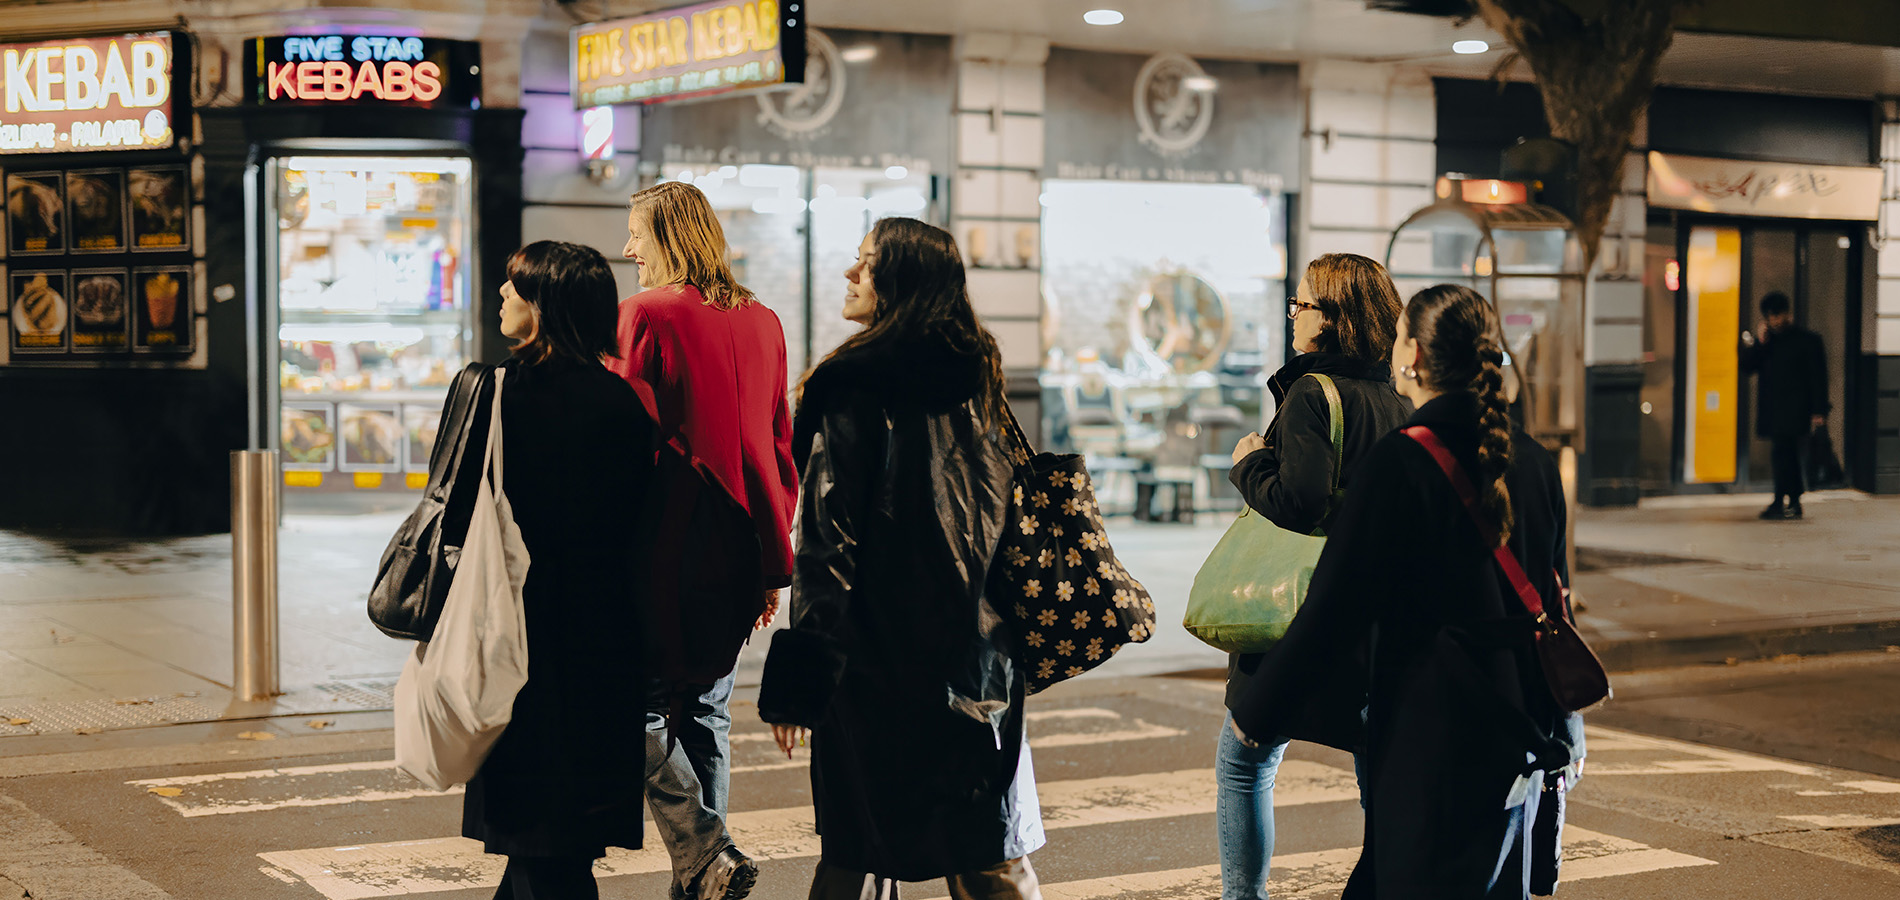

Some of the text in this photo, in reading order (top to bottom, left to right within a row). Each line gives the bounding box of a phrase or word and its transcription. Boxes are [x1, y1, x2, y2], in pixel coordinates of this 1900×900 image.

[284, 37, 424, 62] FIVE STAR
[578, 0, 779, 81] FIVE STAR KEBAB
[4, 40, 170, 113] KEBAB
[268, 60, 441, 101] KEBABS
